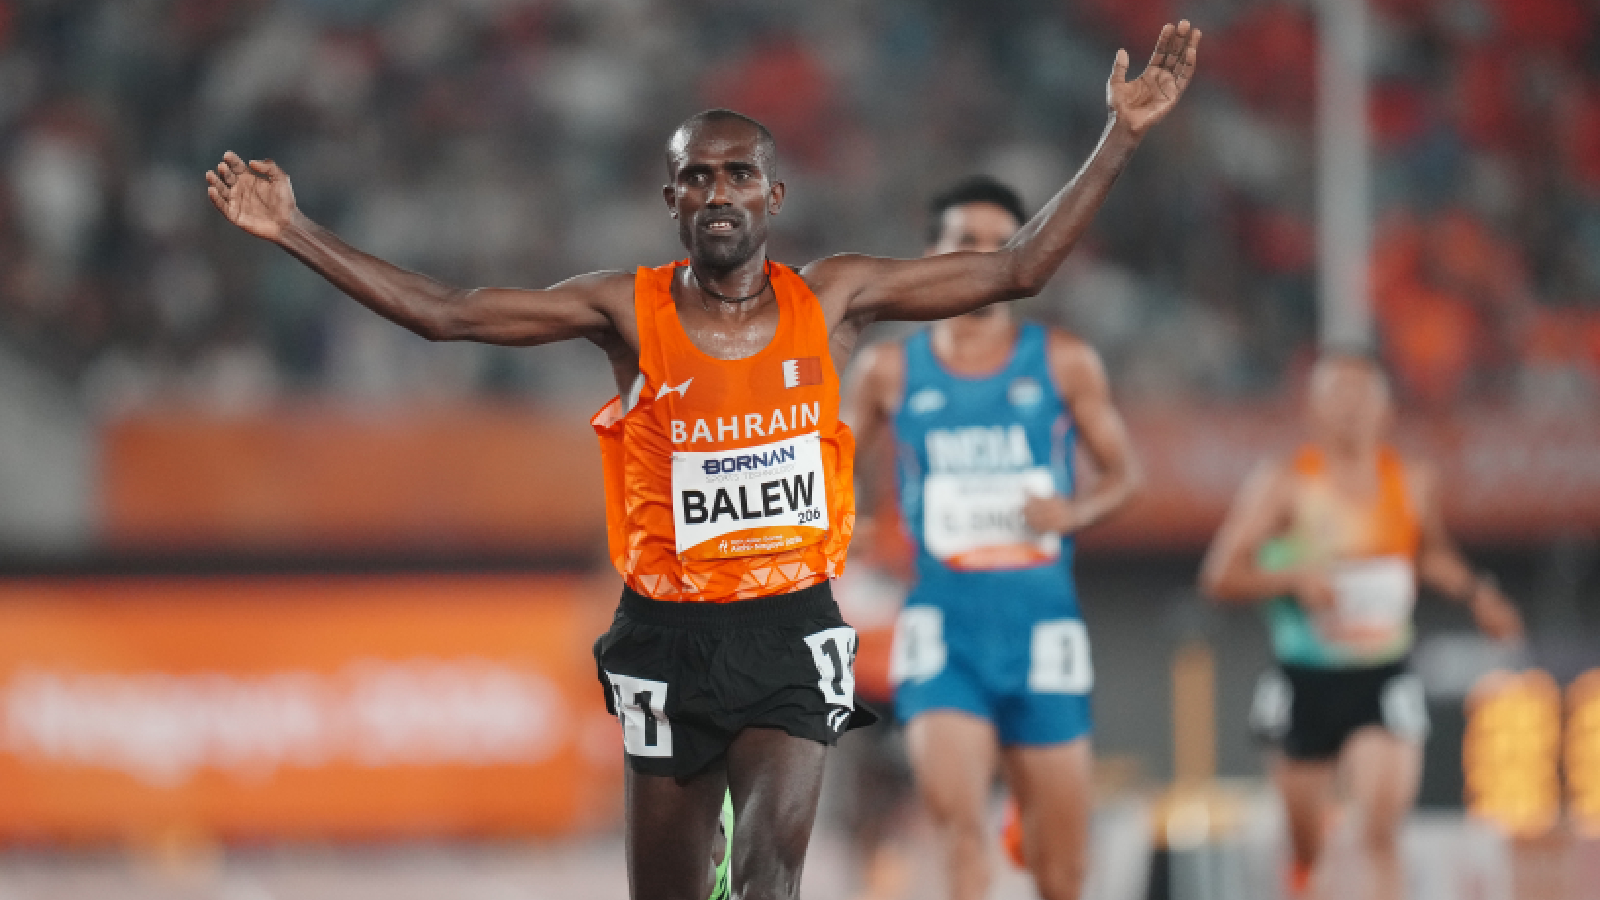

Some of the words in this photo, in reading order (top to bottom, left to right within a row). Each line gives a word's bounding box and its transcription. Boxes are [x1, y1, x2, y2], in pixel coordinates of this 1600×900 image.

[671, 401, 821, 444] BAHRAIN
[702, 444, 796, 475] BORNAN
[706, 473, 740, 484] SPORTS
[682, 472, 815, 526] BALEW
[797, 507, 821, 525] 206
